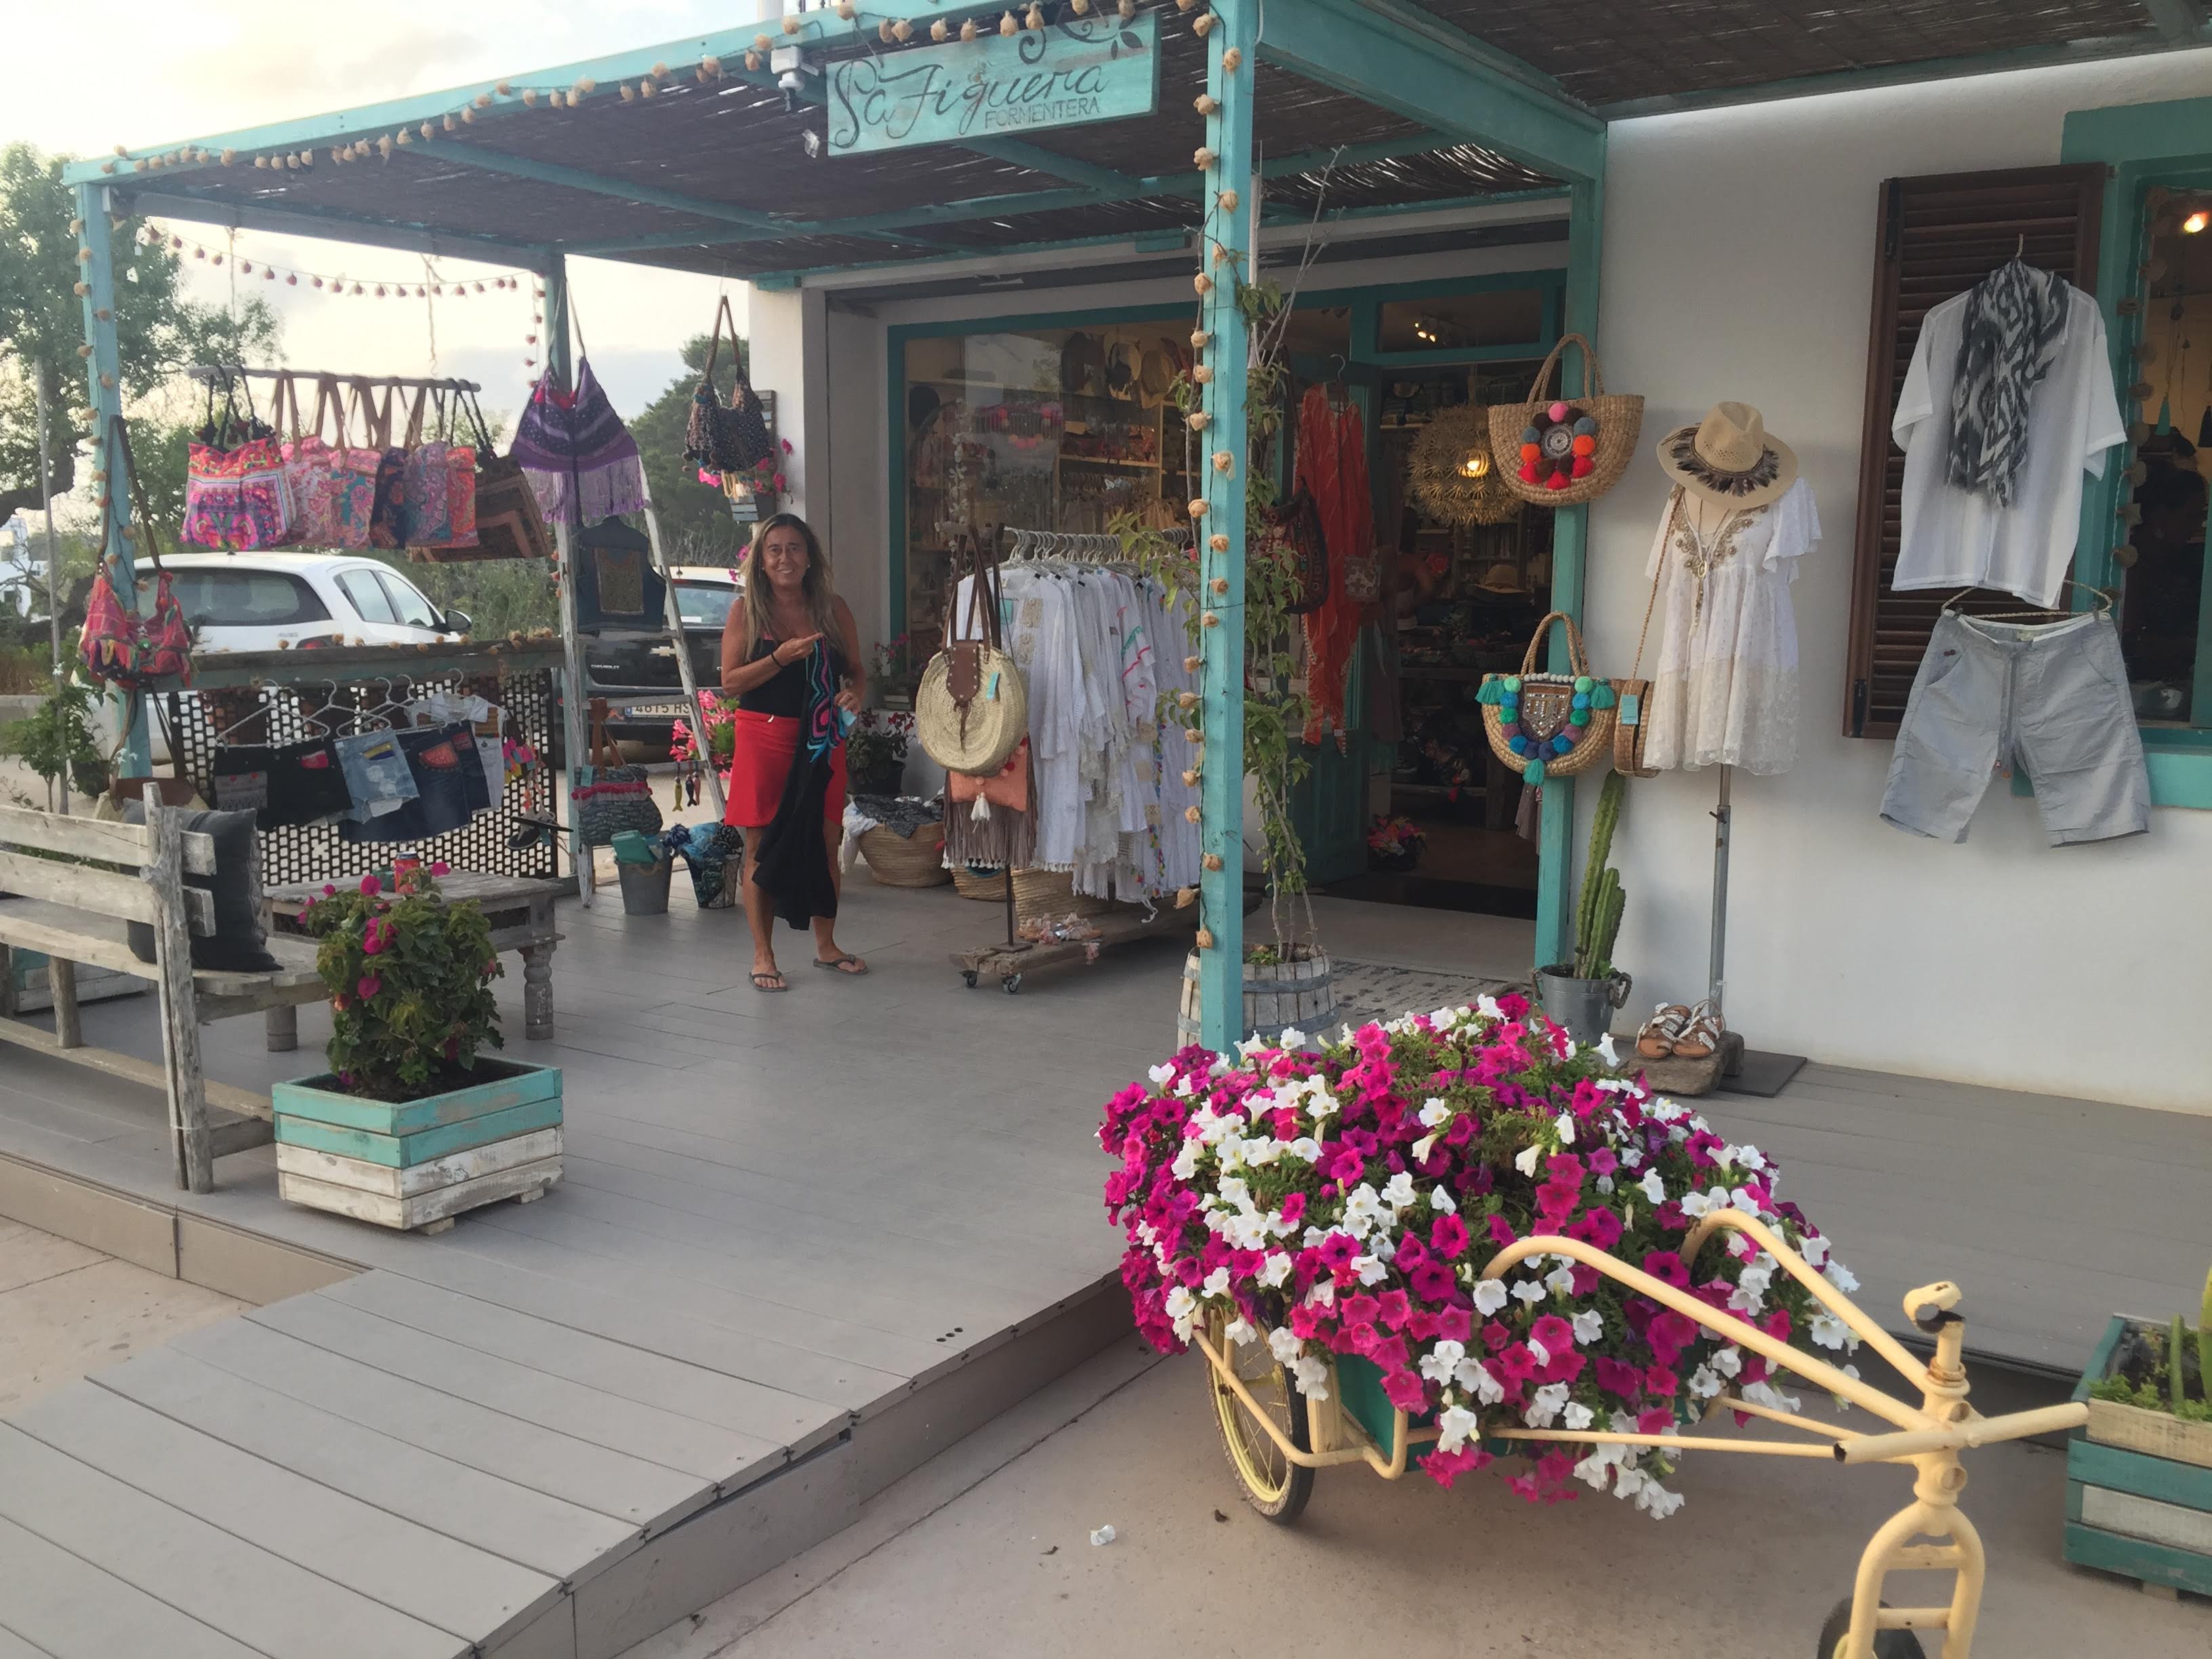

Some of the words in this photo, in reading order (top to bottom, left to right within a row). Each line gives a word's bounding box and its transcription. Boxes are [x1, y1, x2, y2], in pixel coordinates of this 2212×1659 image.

[829, 58, 895, 148] Sa
[878, 64, 1108, 139] Figuera
[985, 96, 1100, 129] FORMENTERA
